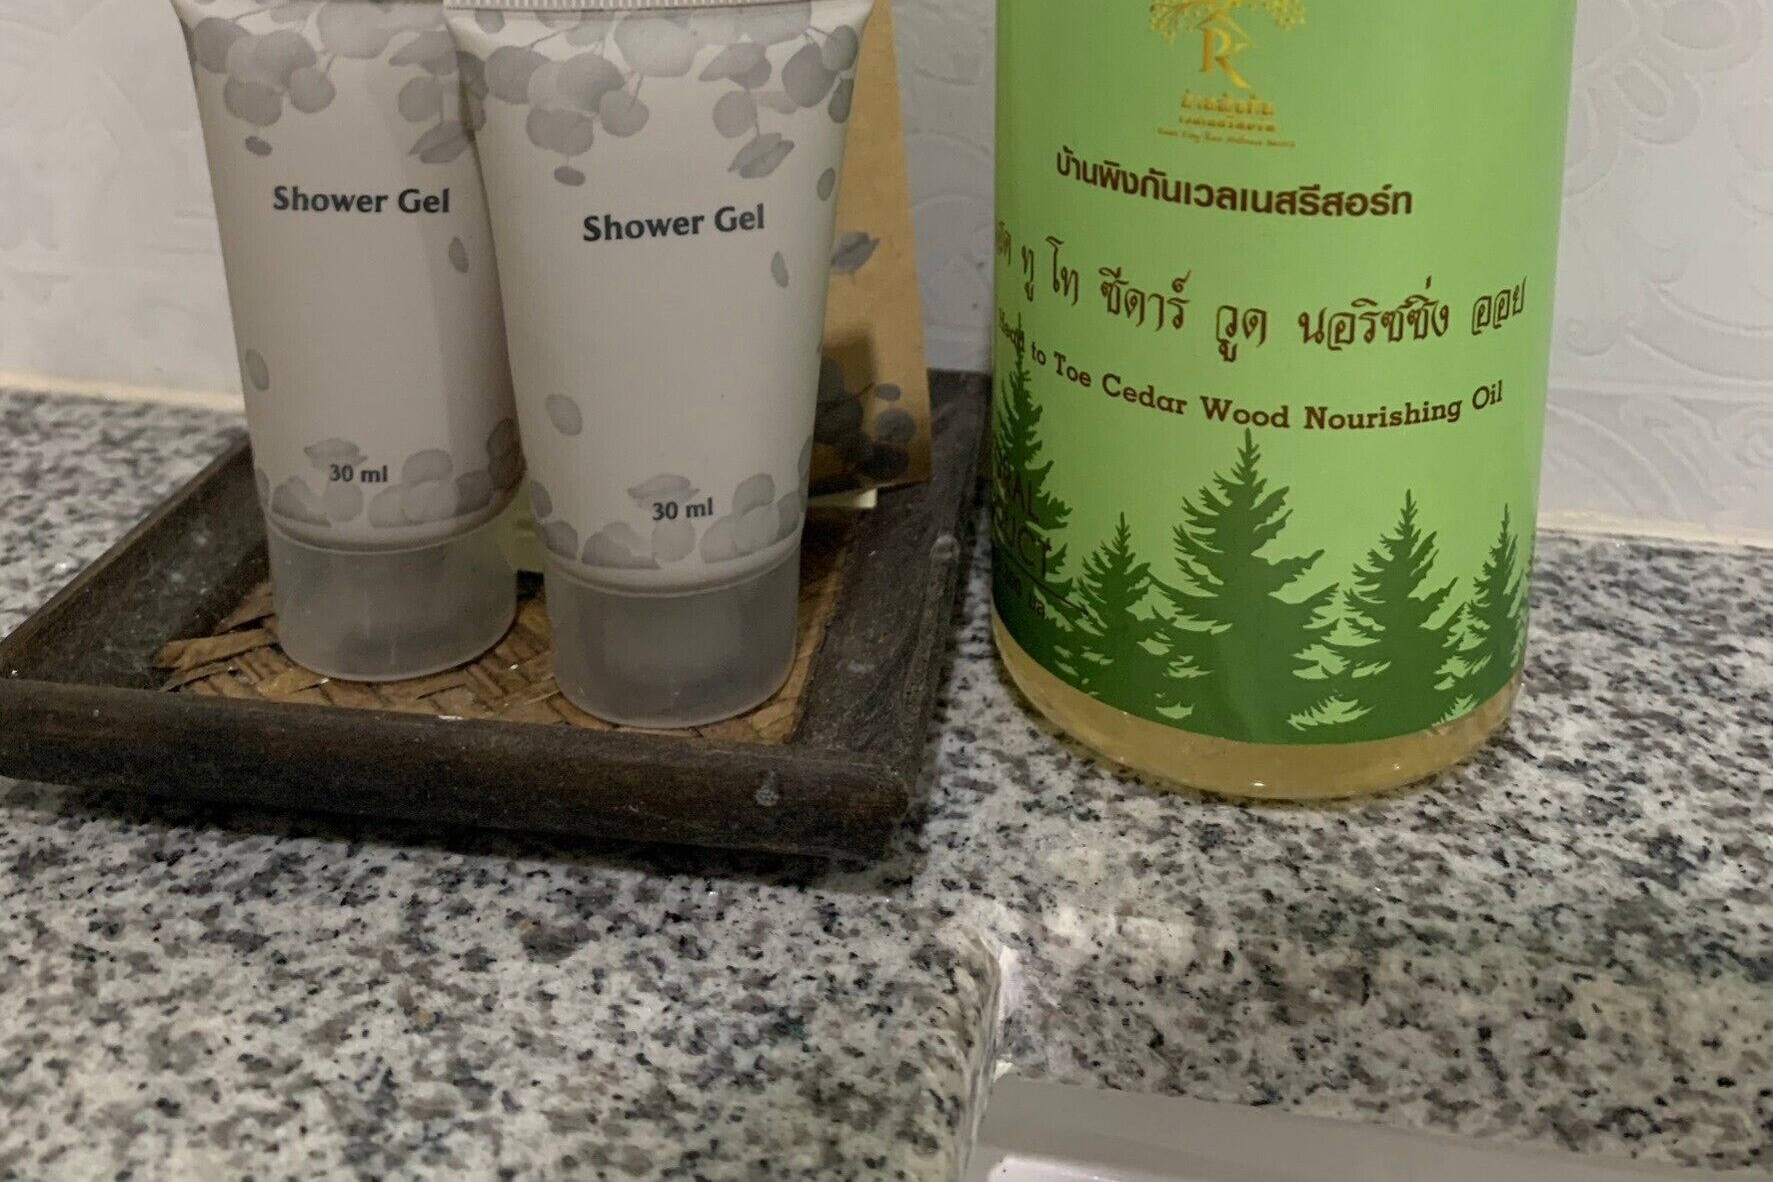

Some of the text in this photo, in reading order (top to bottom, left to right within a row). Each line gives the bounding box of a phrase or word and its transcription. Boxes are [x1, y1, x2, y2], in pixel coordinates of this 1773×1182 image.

[273, 185, 450, 214] Shower Gel
[1057, 145, 1412, 217] บ้านพิงกันเวลเนสรีสอร์ท
[583, 204, 765, 242] Shower Gel
[1098, 266, 1191, 332] ซีดาร์
[1215, 304, 1267, 363] วูด
[1030, 341, 1047, 366] to
[1053, 350, 1092, 388] Toe
[1101, 372, 1188, 415] Cedar
[1199, 395, 1291, 431] Wood
[1303, 399, 1463, 430] Nourishing
[1471, 379, 1503, 411] Oil
[329, 464, 389, 484] 30 ml
[652, 497, 714, 521] 30 ml
